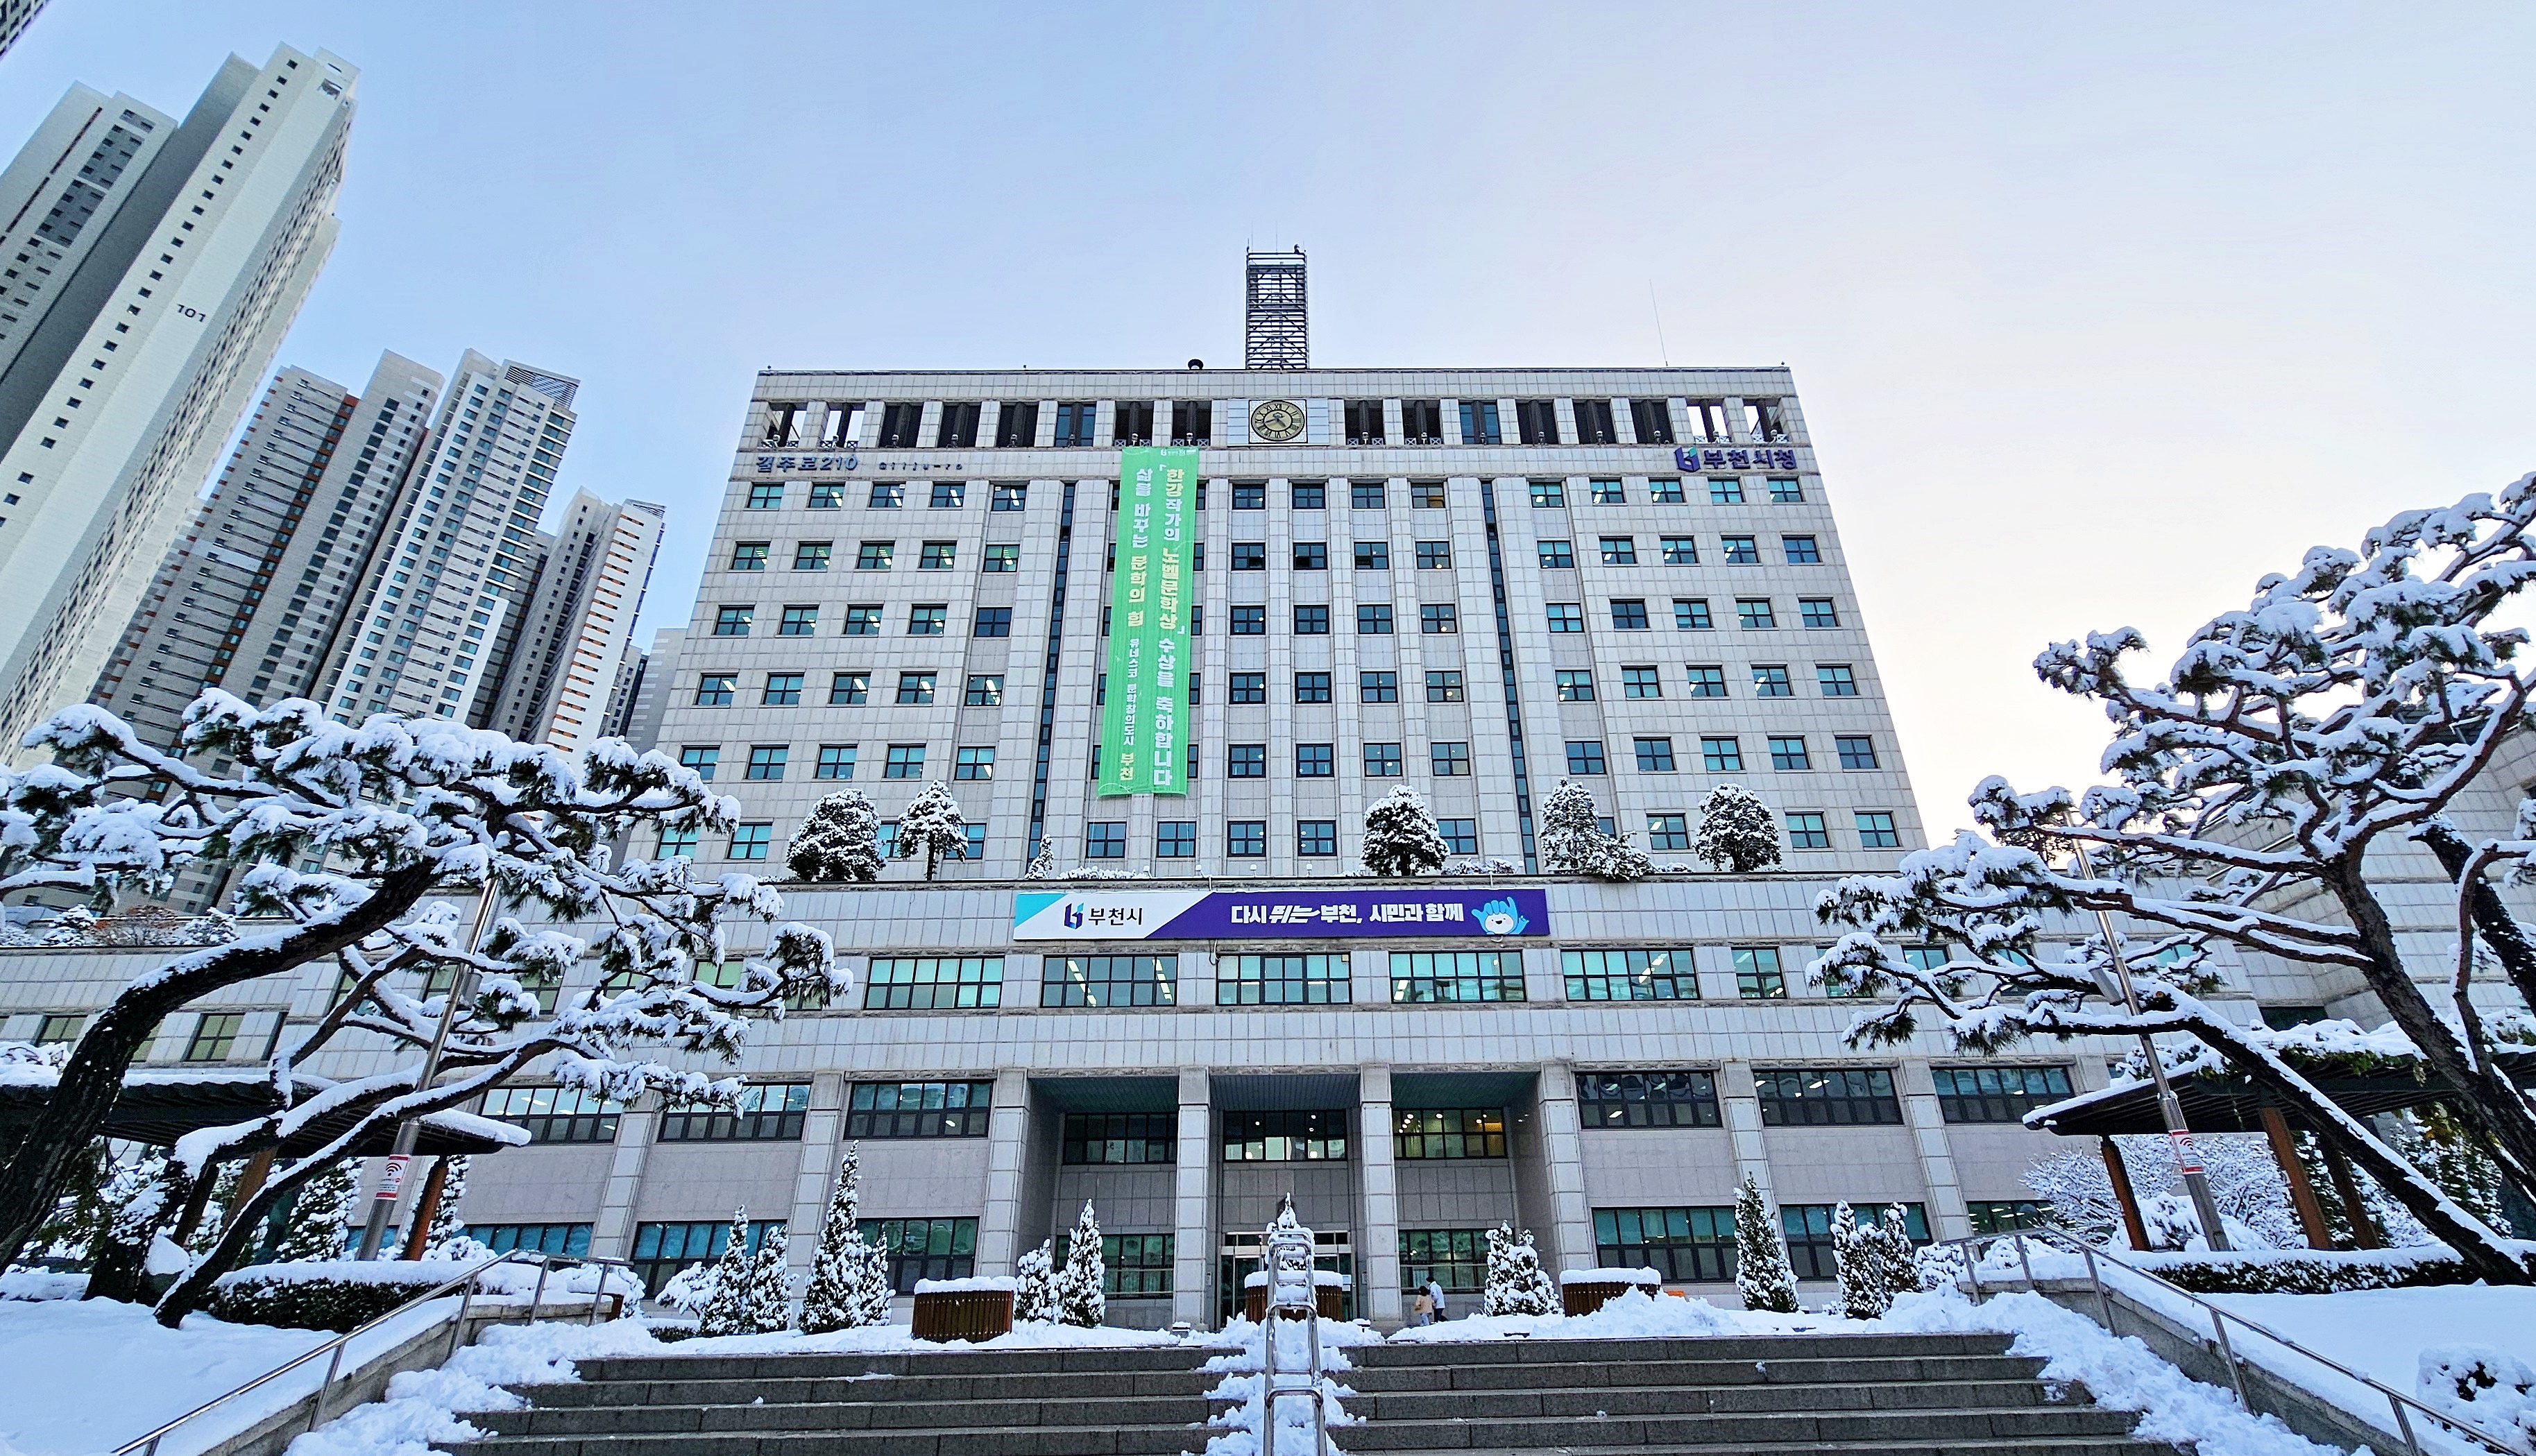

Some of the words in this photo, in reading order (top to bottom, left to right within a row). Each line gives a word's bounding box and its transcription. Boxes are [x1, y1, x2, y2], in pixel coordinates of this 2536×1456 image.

[177, 304, 206, 323] 101
[1703, 449, 1798, 470] 부천시청
[1136, 468, 1152, 497] 삶을
[1132, 503, 1150, 548] 바꾸는
[1129, 555, 1147, 603] 문학의
[1127, 610, 1143, 627] 힘
[1158, 638, 1175, 687] 수상을
[1154, 696, 1173, 785] 축하합니다
[1120, 753, 1134, 780] 부천
[1089, 907, 1142, 925] 부천시
[1231, 905, 1266, 923] 다시
[1269, 905, 1320, 923] 뛰는
[1320, 905, 1363, 923] 부천,
[1370, 904, 1423, 922] 시민과
[1426, 903, 1464, 921] 함께
